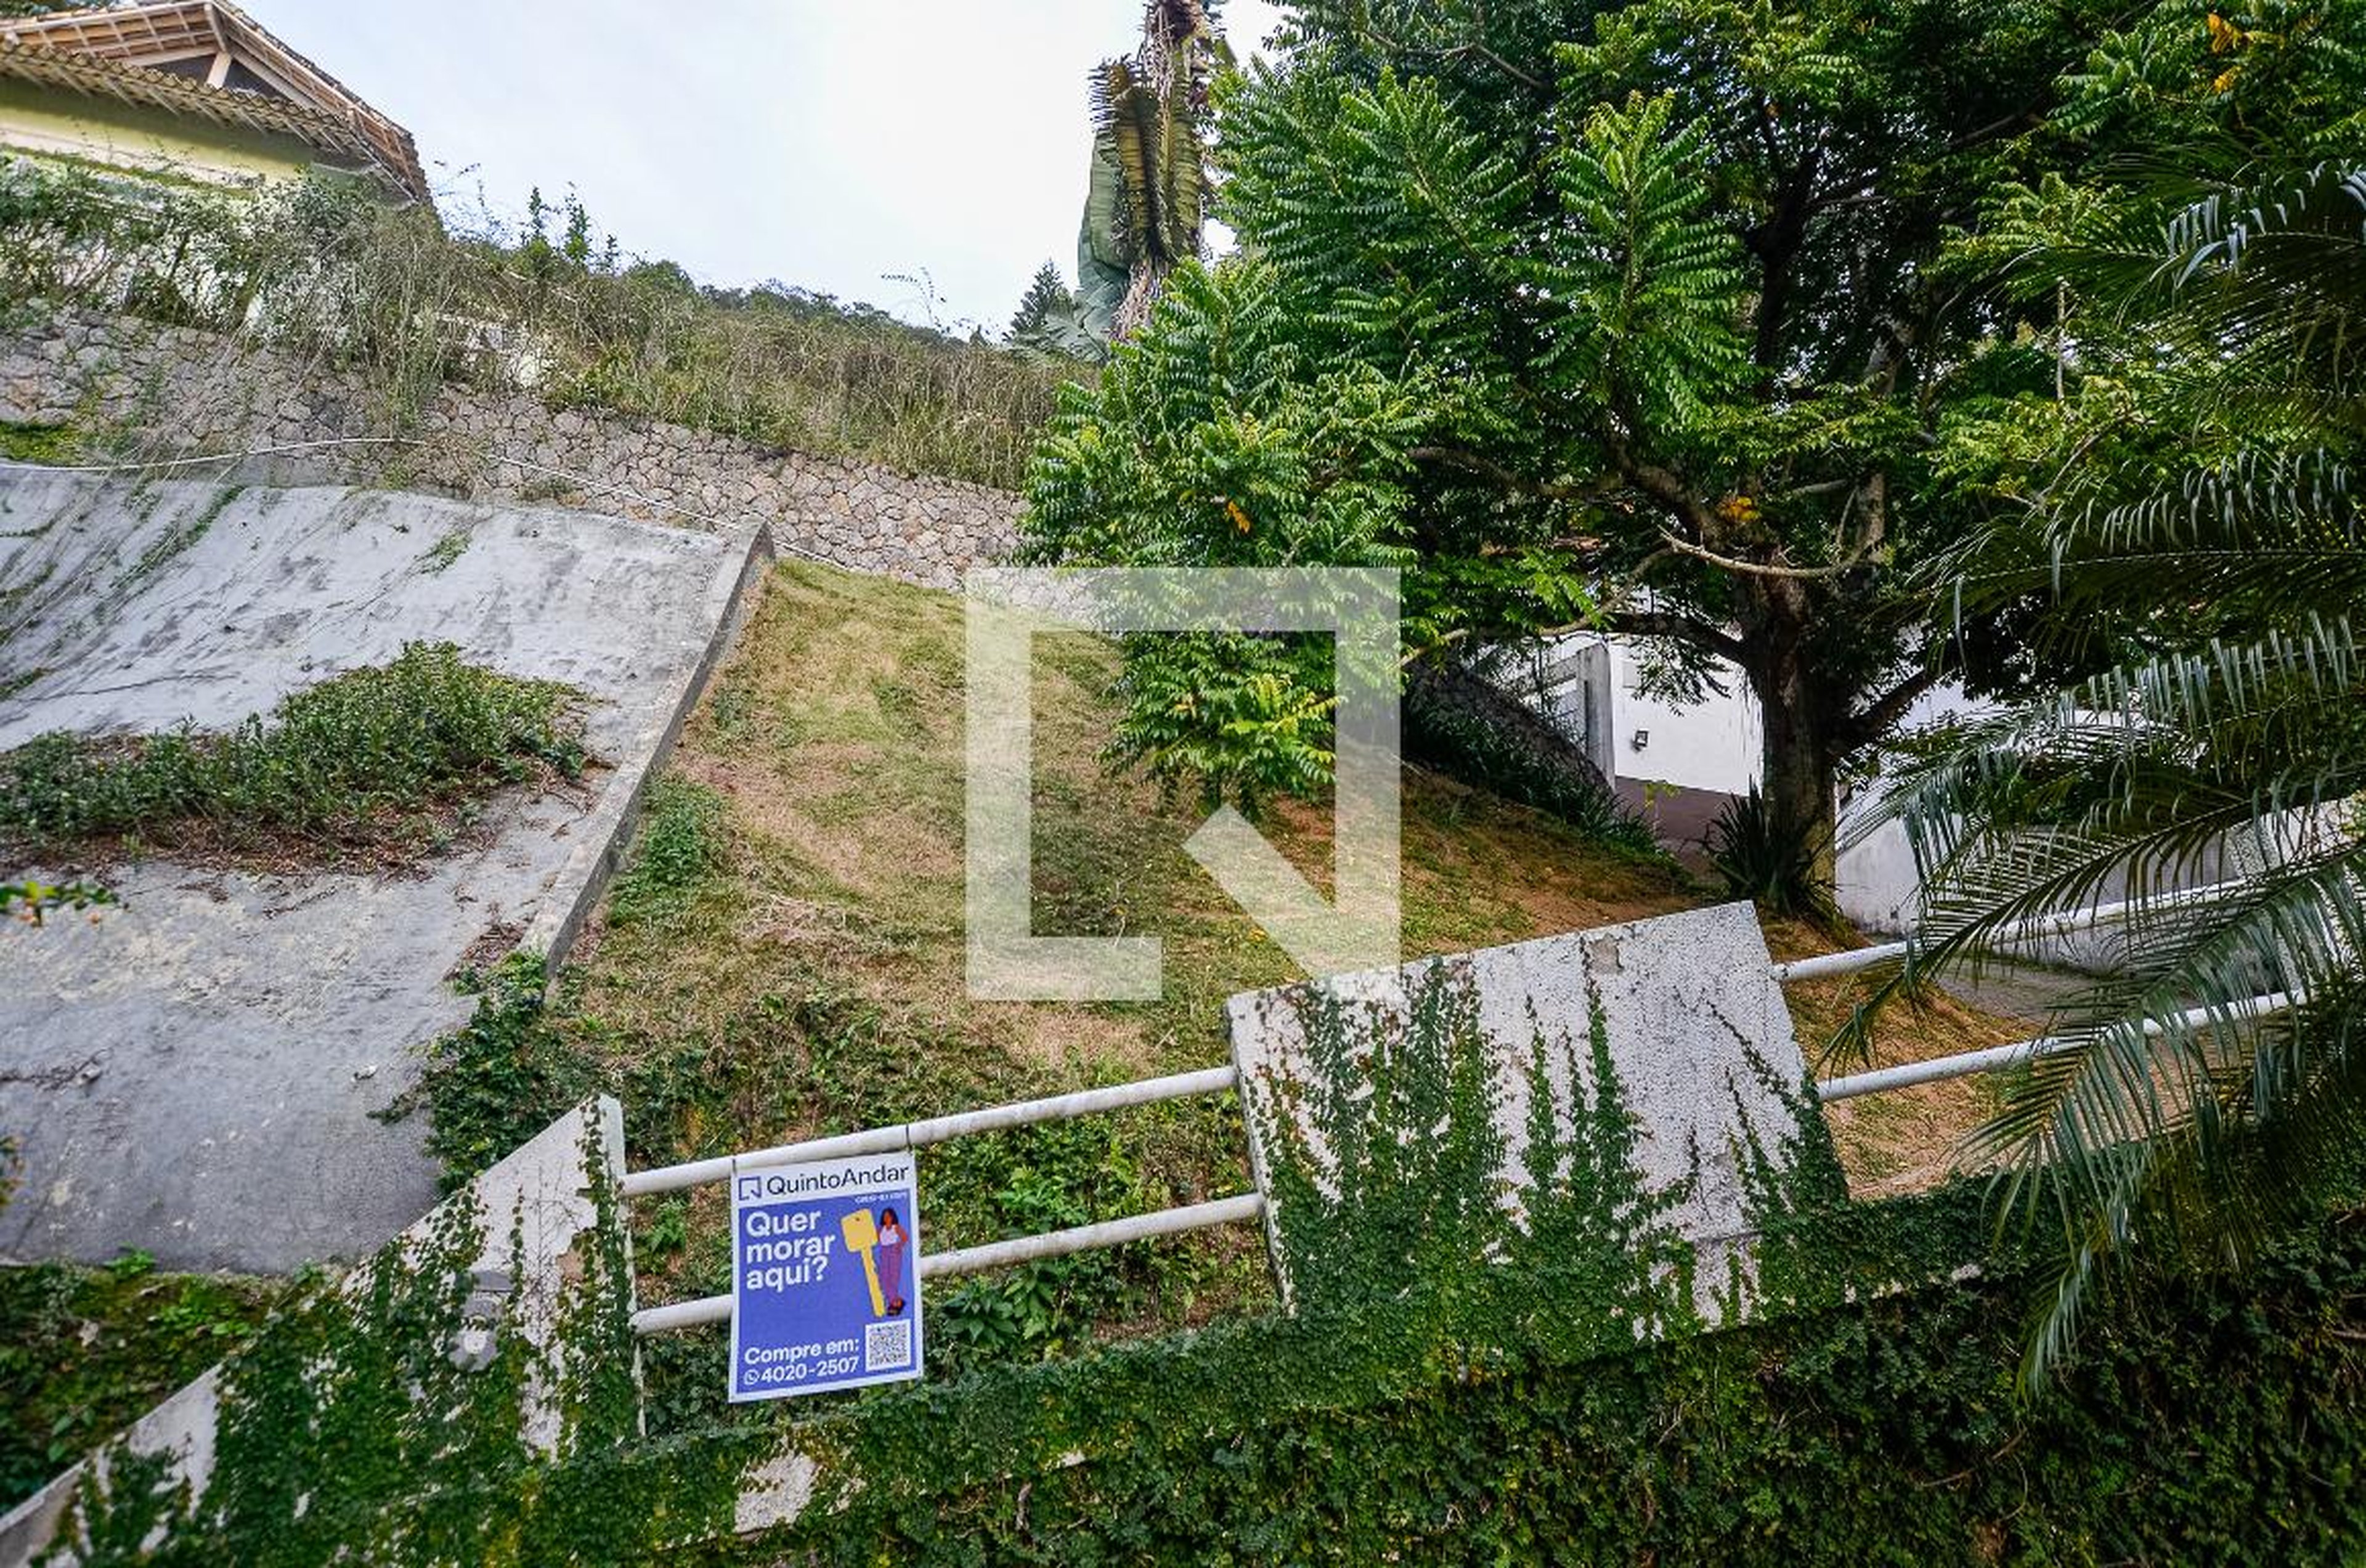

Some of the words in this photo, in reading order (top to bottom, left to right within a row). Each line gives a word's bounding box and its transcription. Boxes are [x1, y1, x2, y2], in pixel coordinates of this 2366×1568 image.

[767, 1166, 909, 1195] QuintoAndar
[746, 1209, 821, 1237] Quer
[746, 1235, 835, 1264] morar
[747, 1256, 828, 1292] aqui?
[744, 1343, 821, 1364] Compre
[826, 1338, 860, 1354] em:
[760, 1357, 860, 1383] 4020-2507
